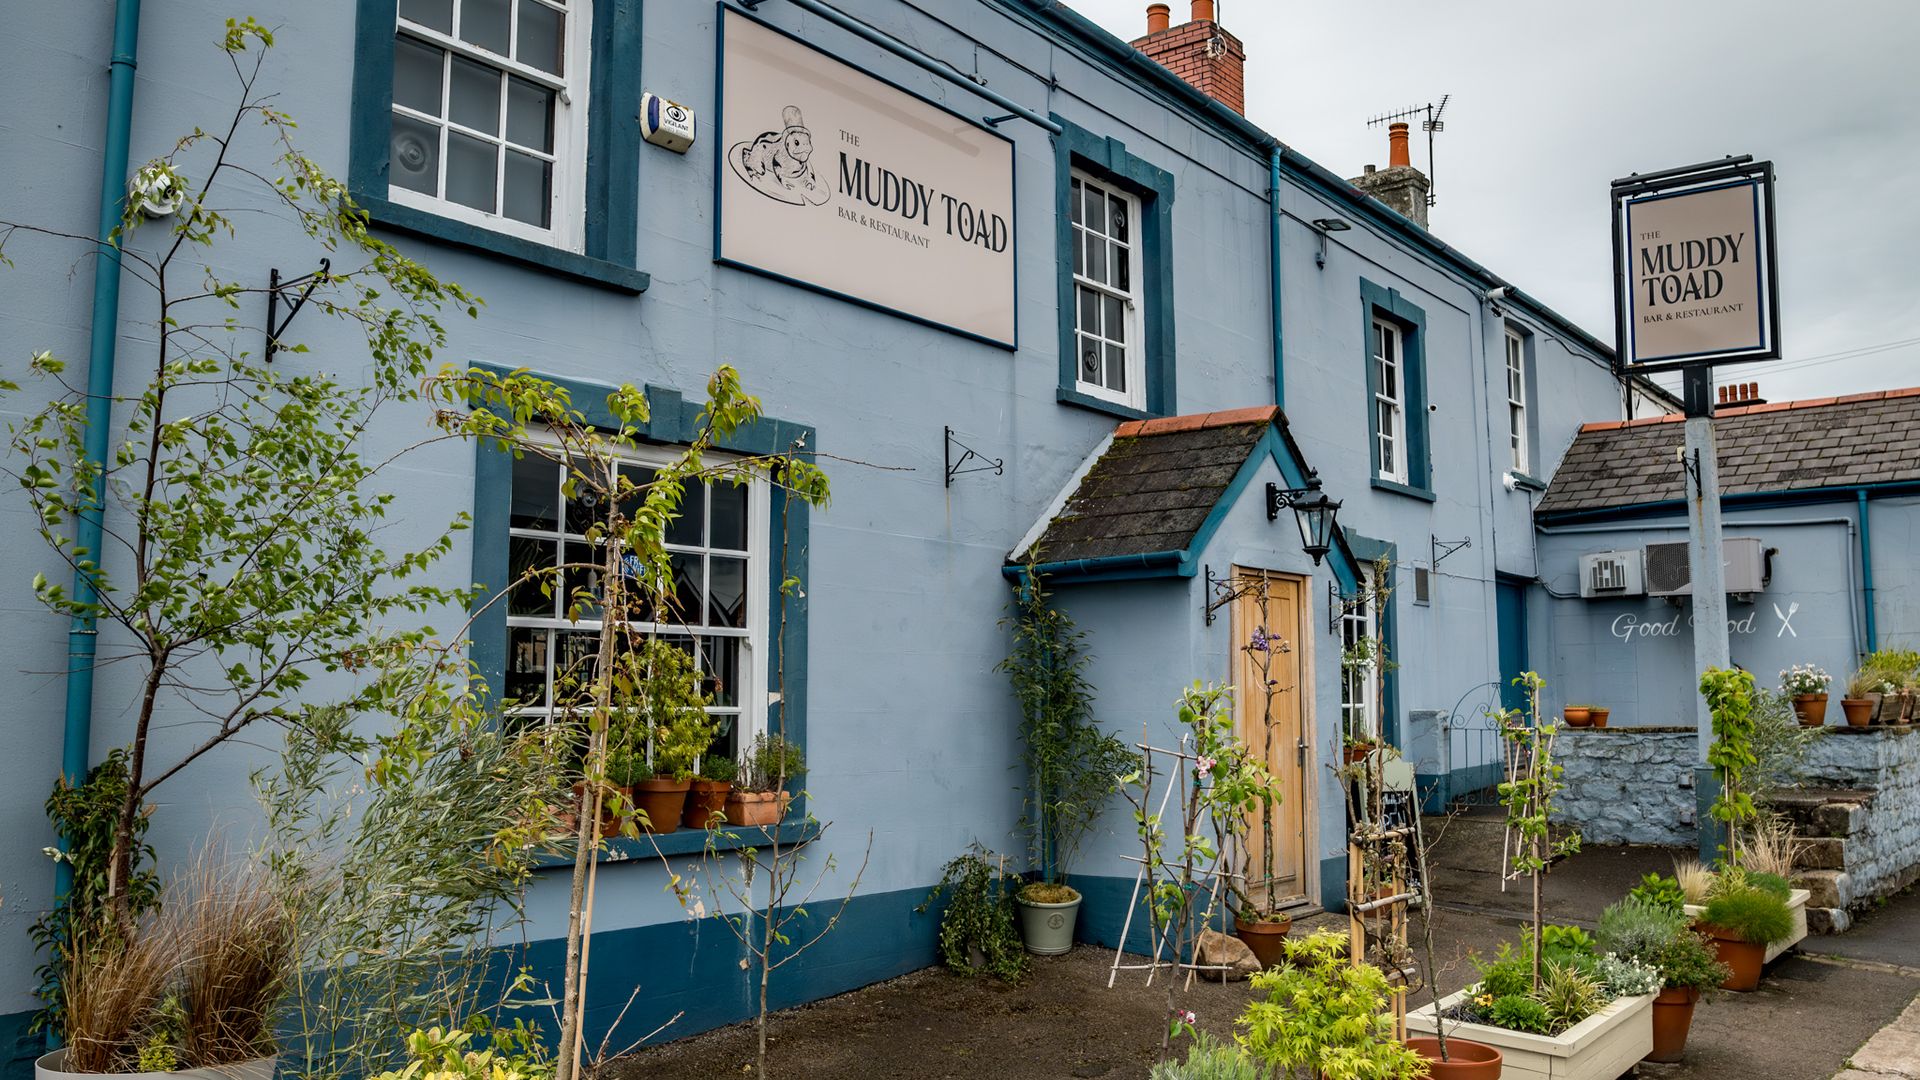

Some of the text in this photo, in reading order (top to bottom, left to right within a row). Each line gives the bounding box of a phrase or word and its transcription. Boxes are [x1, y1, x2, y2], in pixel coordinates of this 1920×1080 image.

[839, 129, 860, 147] THE
[839, 151, 1008, 254] MUDDY TOAD
[838, 206, 931, 249] BAR & RESTAURANT
[1640, 231, 1661, 241] THE
[1641, 232, 1745, 276] MUDDY
[1642, 269, 1724, 307] TOAD
[1643, 303, 1744, 324] BAR & RESTAURANT
[1611, 611, 1757, 643] Good od
